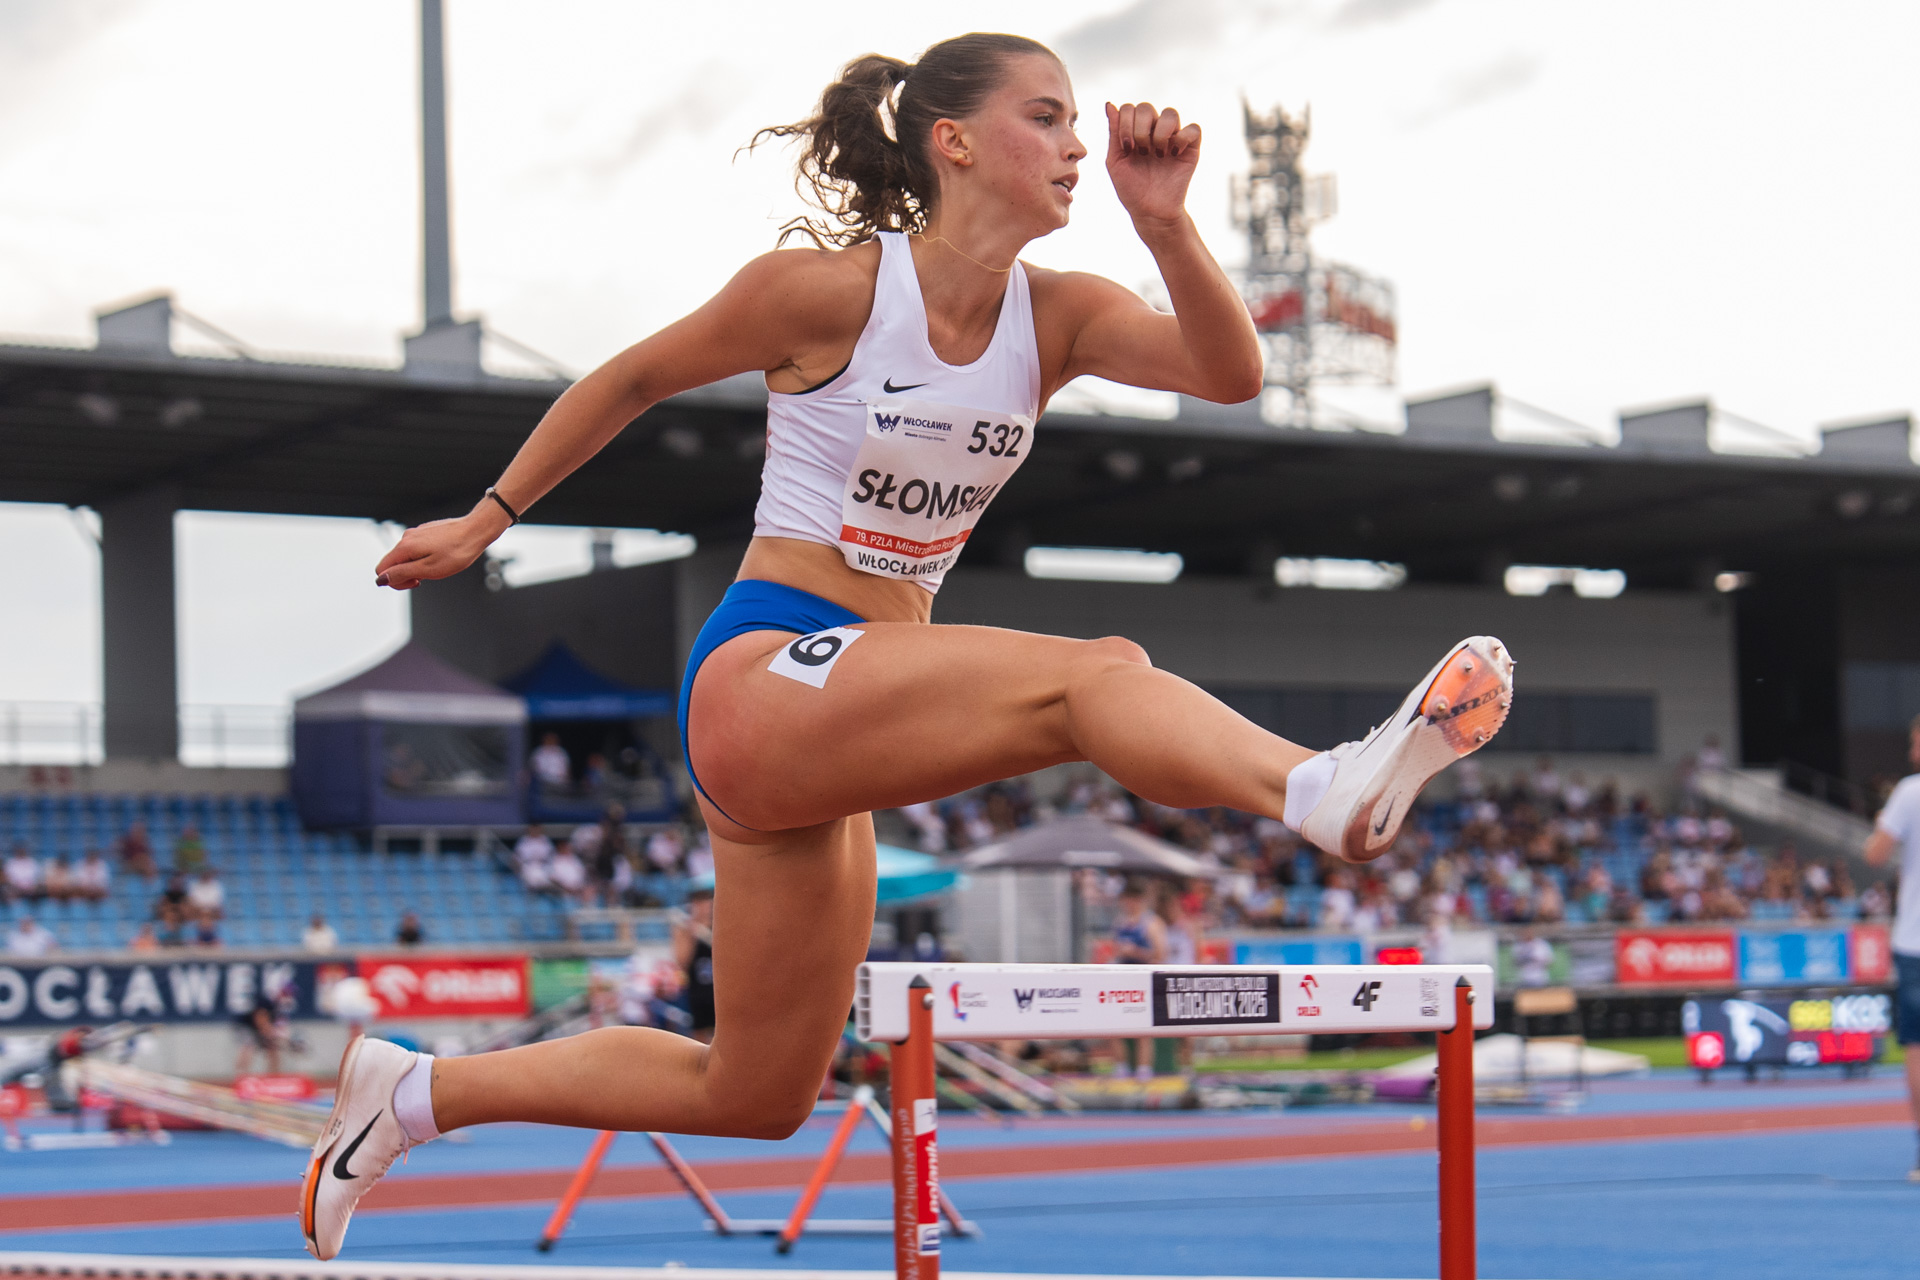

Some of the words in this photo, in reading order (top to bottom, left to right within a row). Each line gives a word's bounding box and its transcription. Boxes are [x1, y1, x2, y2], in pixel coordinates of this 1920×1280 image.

[903, 416, 953, 431] WŁOCŁAWEK
[967, 420, 1024, 457] 532
[852, 468, 999, 521] SŁOMSKA
[855, 531, 868, 543] 79.
[870, 535, 893, 548] PZLA
[857, 551, 940, 576] WŁOCŁAWEK
[788, 634, 843, 667] 6
[1351, 980, 1383, 1012] 4F
